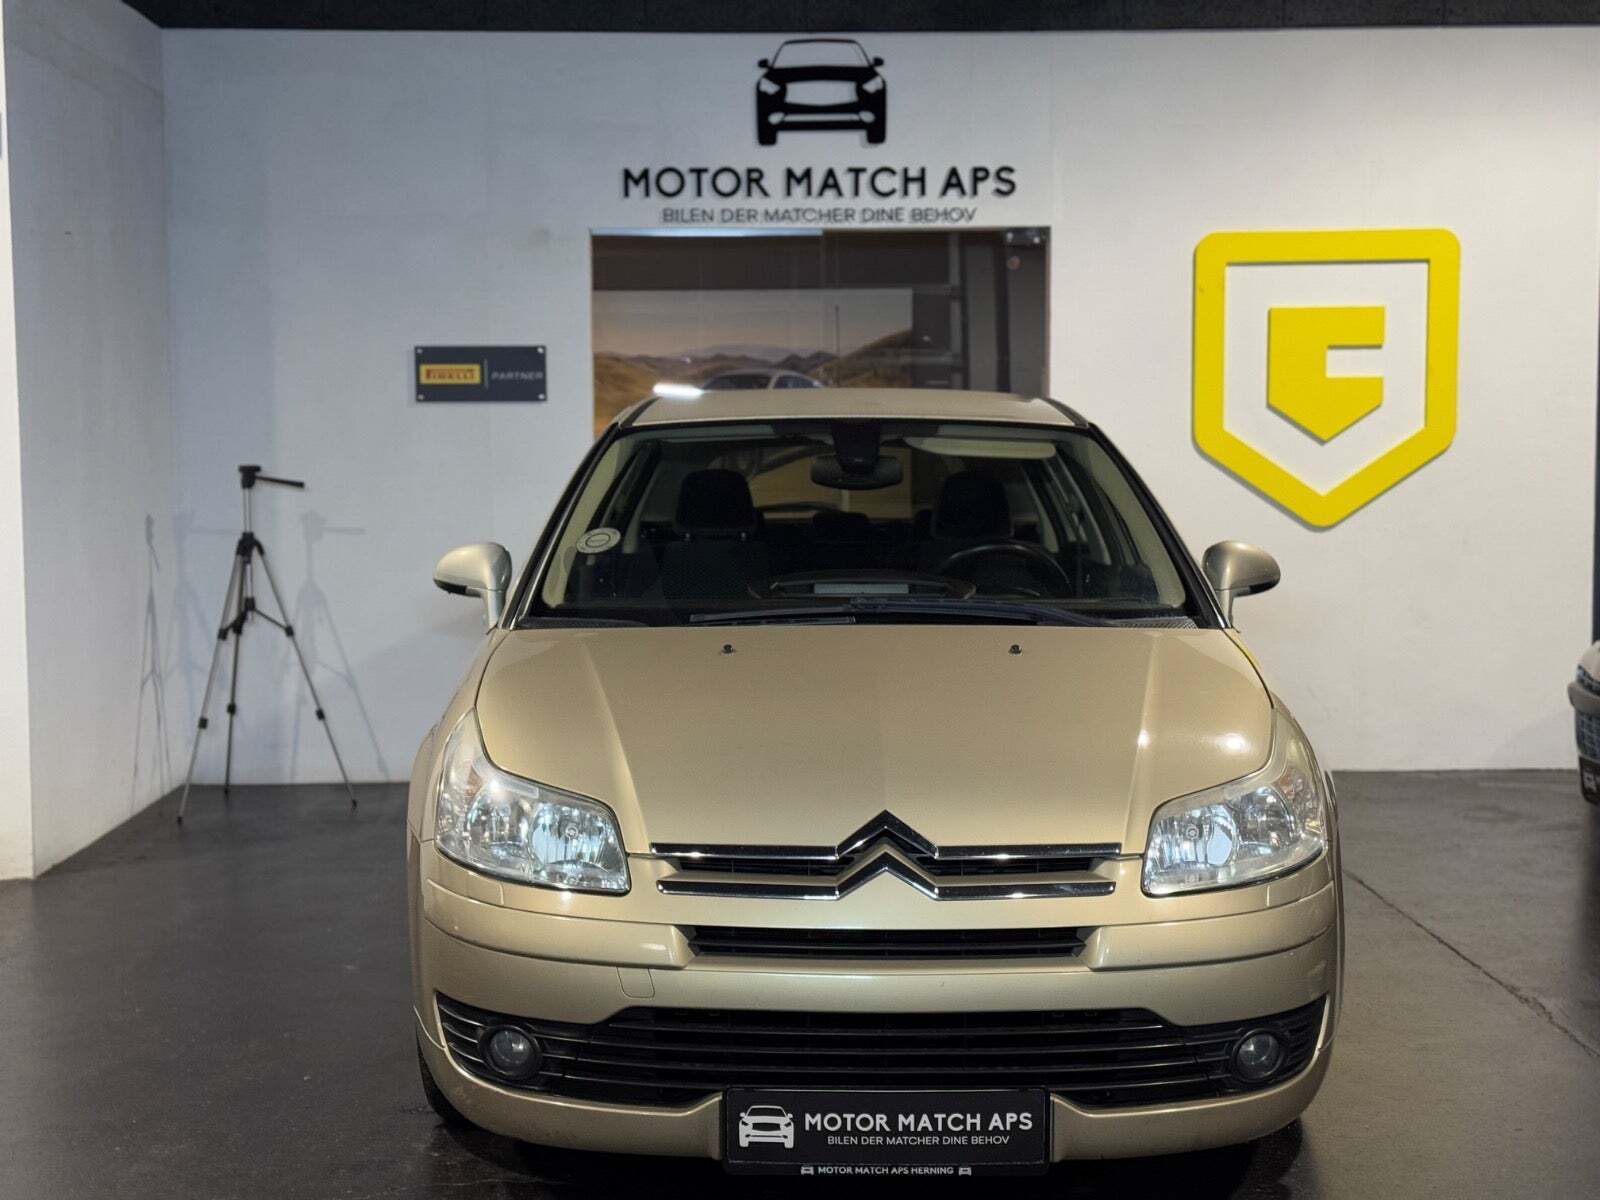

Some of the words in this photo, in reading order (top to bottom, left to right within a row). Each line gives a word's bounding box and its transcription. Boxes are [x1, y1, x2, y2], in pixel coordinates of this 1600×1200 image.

[623, 166, 770, 198] MOTOR
[785, 166, 926, 198] MATCH
[941, 166, 1017, 197] APS
[662, 207, 714, 223] BILEN
[720, 207, 759, 223] DER
[763, 207, 856, 223] MATCHER
[860, 207, 906, 223] DINE
[910, 207, 977, 223] BEHOV
[491, 371, 544, 380] PARTNER
[804, 1113, 891, 1132] MOTOR
[898, 1113, 981, 1132] MATCH
[988, 1112, 1033, 1131] APS
[827, 1136, 858, 1145] BILEN
[861, 1136, 883, 1145] DER
[886, 1136, 940, 1145] MATCHER
[942, 1136, 968, 1145] DINE
[971, 1135, 1010, 1145] BEHOV
[818, 1166, 853, 1175] MOTOR
[855, 1166, 889, 1175] MATCH
[890, 1166, 910, 1175] APS
[911, 1166, 954, 1175] HERNING
